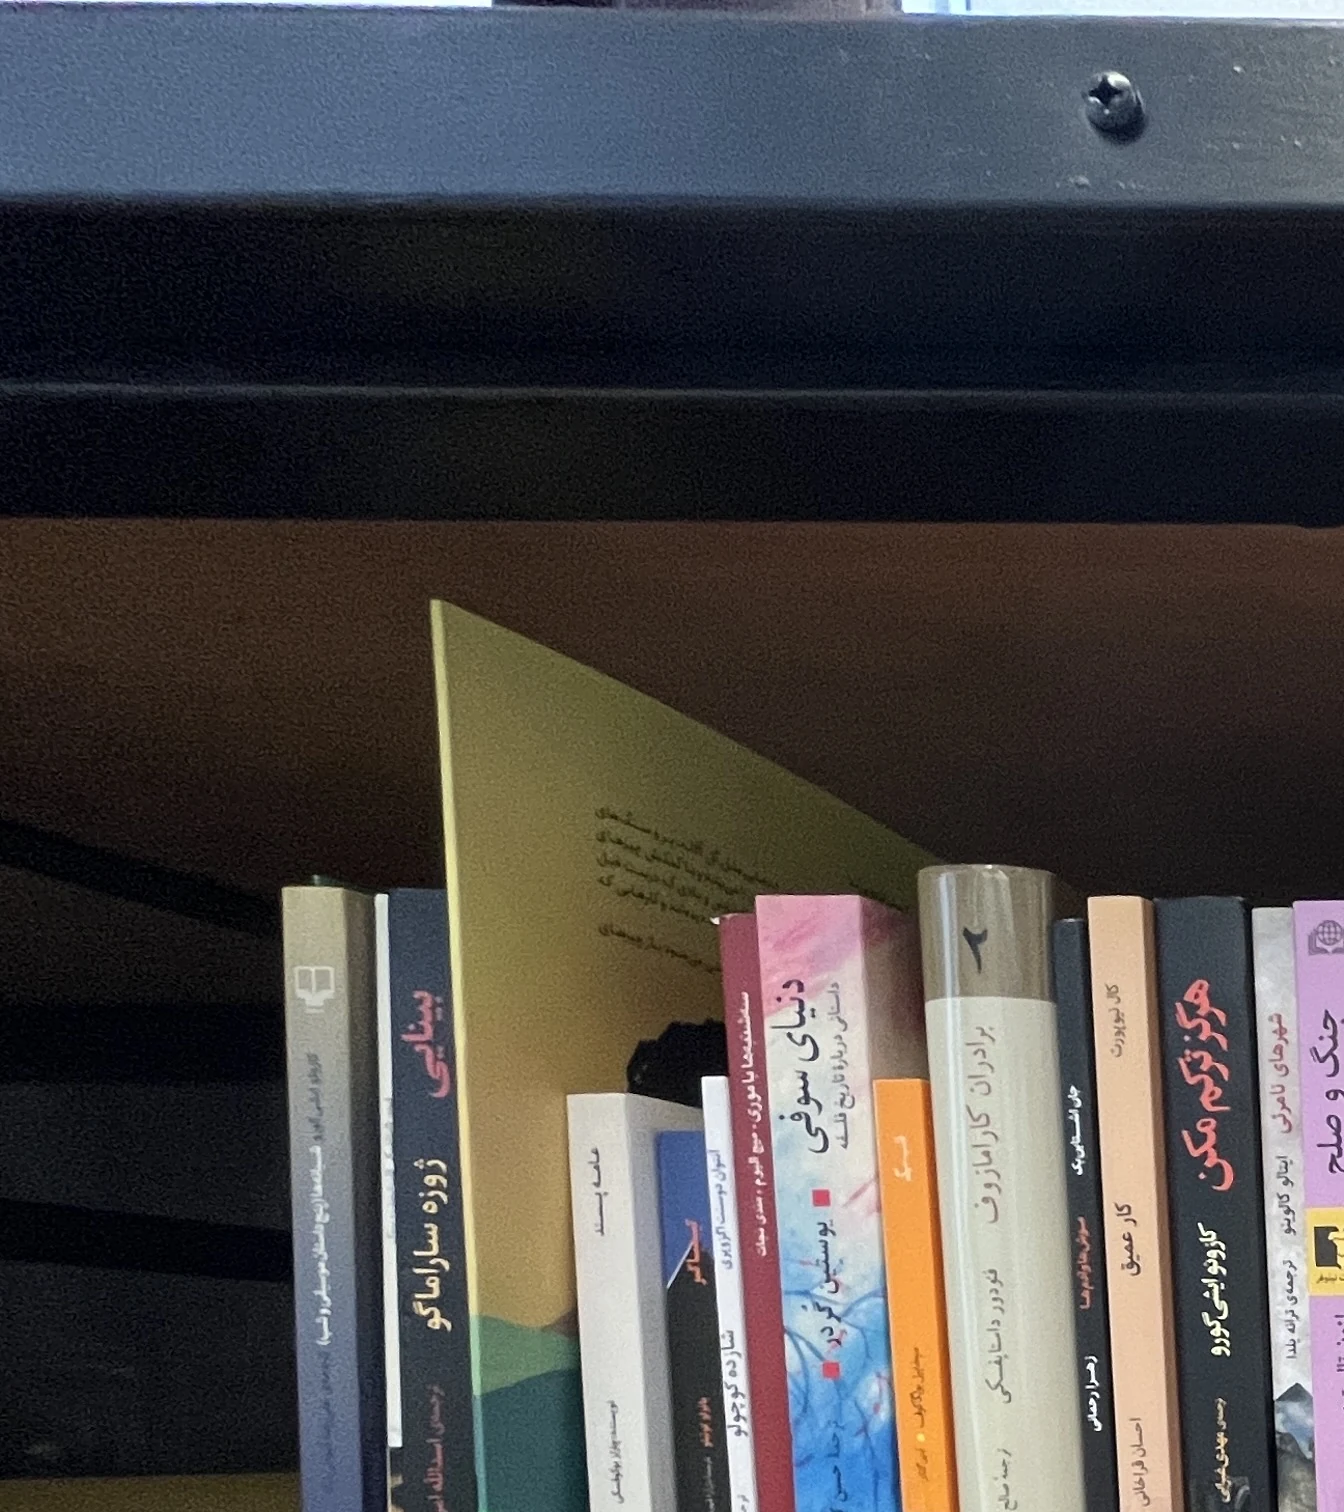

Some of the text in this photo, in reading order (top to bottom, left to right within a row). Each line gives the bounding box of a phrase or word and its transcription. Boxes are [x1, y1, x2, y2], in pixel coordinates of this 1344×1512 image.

[400, 990, 450, 1098] بینایی
[770, 979, 829, 1154] دنیای سوفی
[966, 1027, 1000, 1224] برادران کارامازوف
[1175, 979, 1234, 1191] هرگز ترکم مکن
[412, 1158, 453, 1331] ژوزه ساراماگو
[1114, 1203, 1140, 1277] کار عمیق
[721, 1330, 747, 1438] شازده کوچولو
